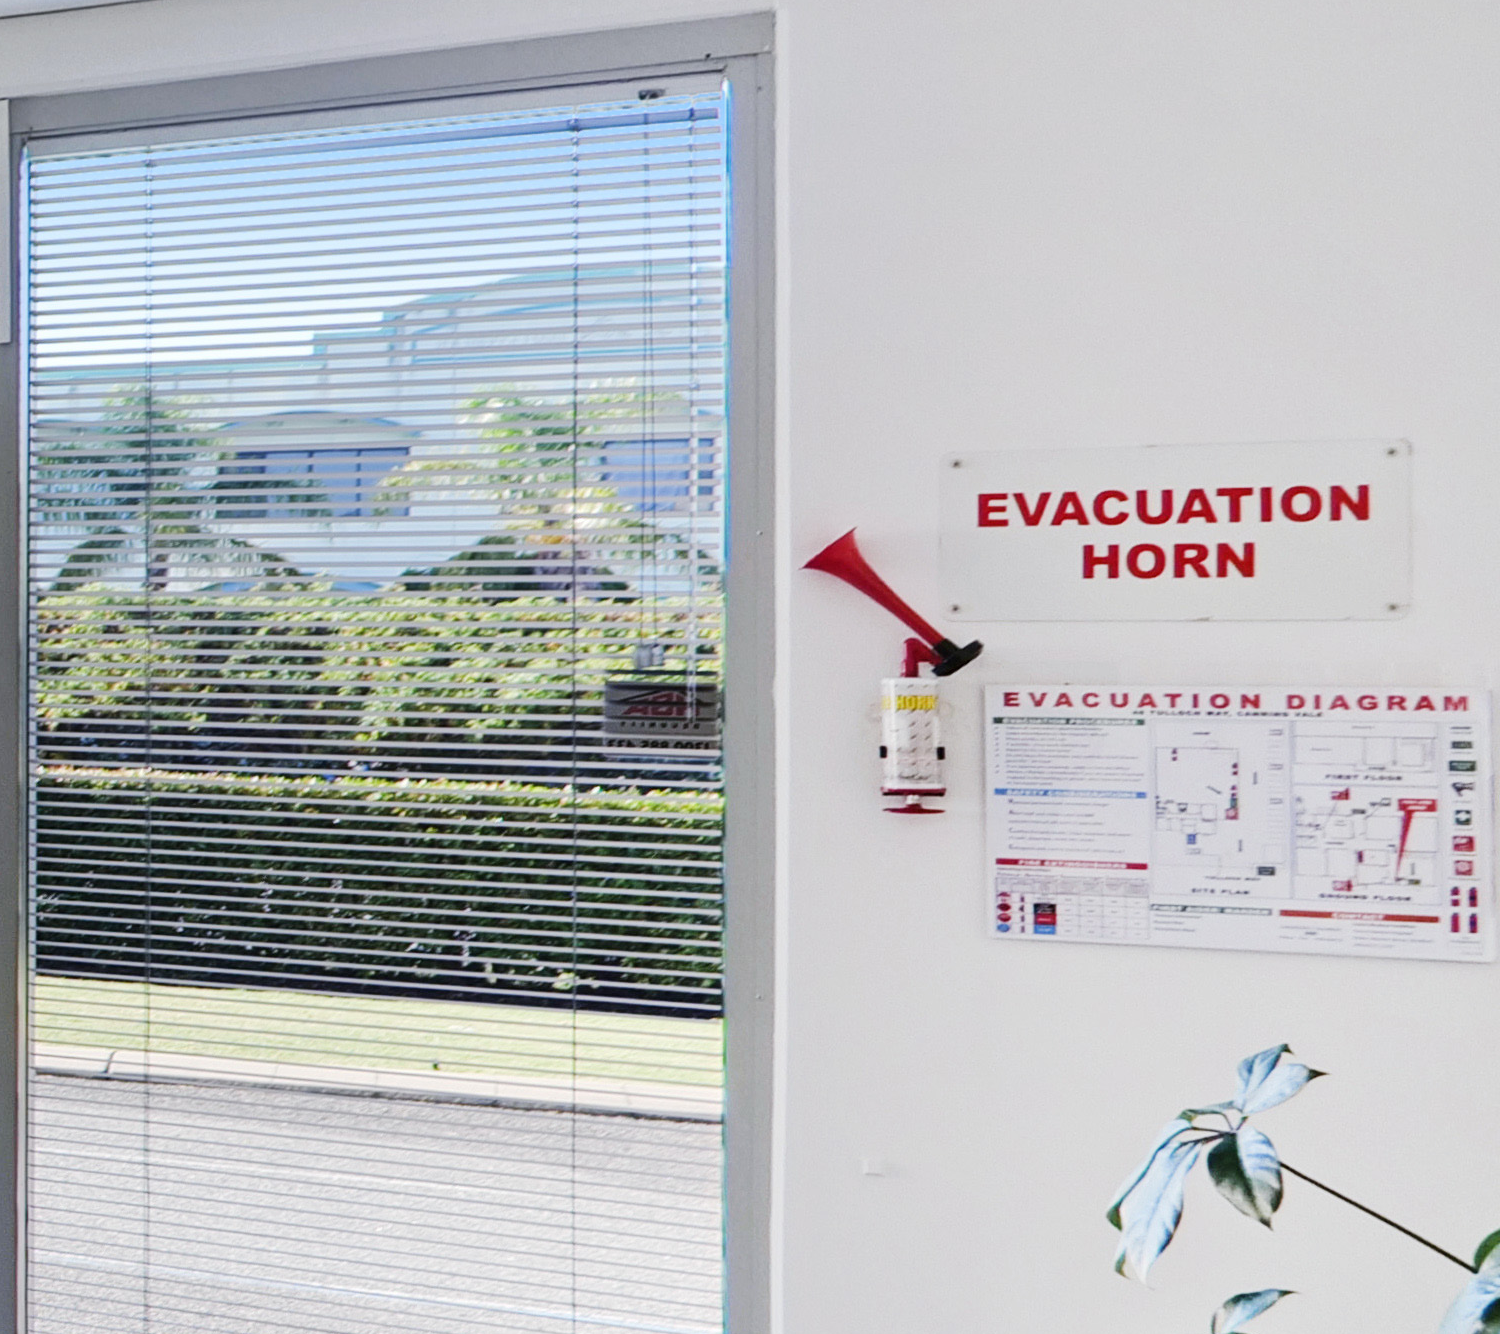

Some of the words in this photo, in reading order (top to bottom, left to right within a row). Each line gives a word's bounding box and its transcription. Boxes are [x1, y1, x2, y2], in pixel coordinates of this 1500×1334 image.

[976, 484, 1370, 528] EVACUATION
[1081, 542, 1256, 579] HORN
[1003, 691, 1263, 710] EVACUATION
[1286, 694, 1470, 712] DIAGRAM
